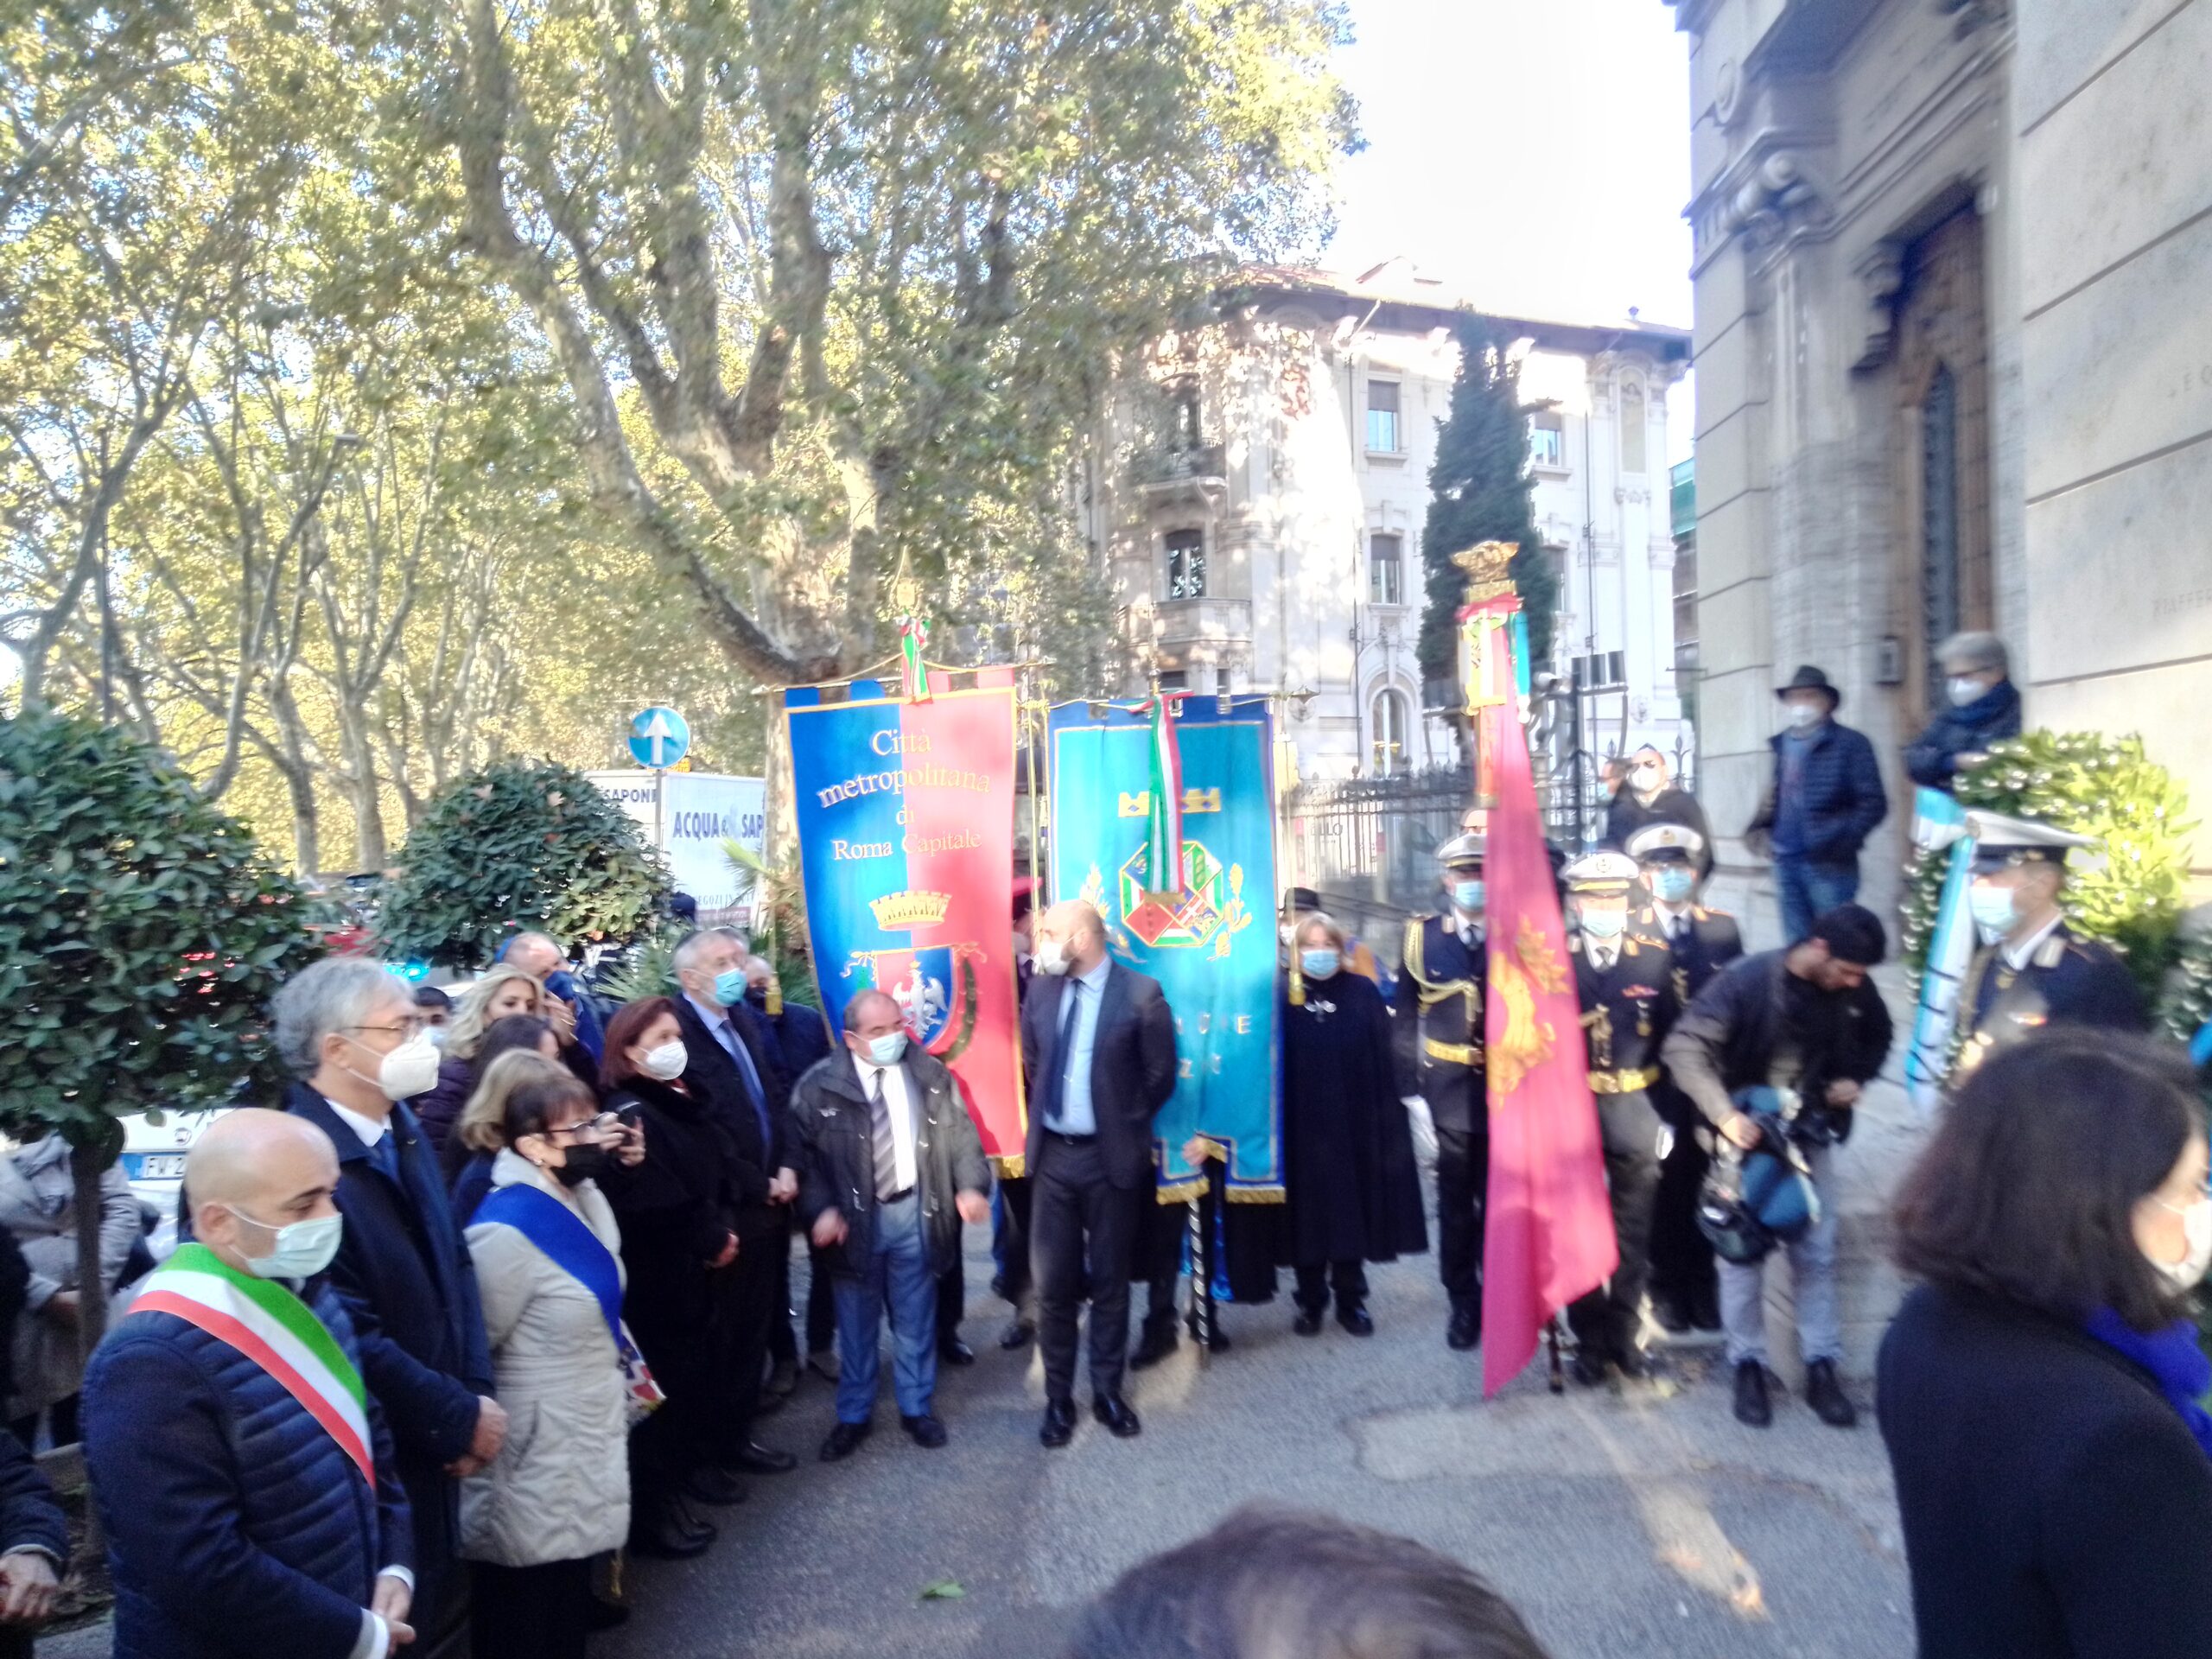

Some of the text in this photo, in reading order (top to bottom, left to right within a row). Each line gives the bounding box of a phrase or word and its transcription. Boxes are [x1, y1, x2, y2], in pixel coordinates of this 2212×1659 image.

[871, 728, 931, 756] Città
[817, 762, 991, 808] metropolitana
[672, 811, 720, 842] ACQUA
[895, 804, 914, 825] di
[831, 830, 982, 861] Roma Capitale
